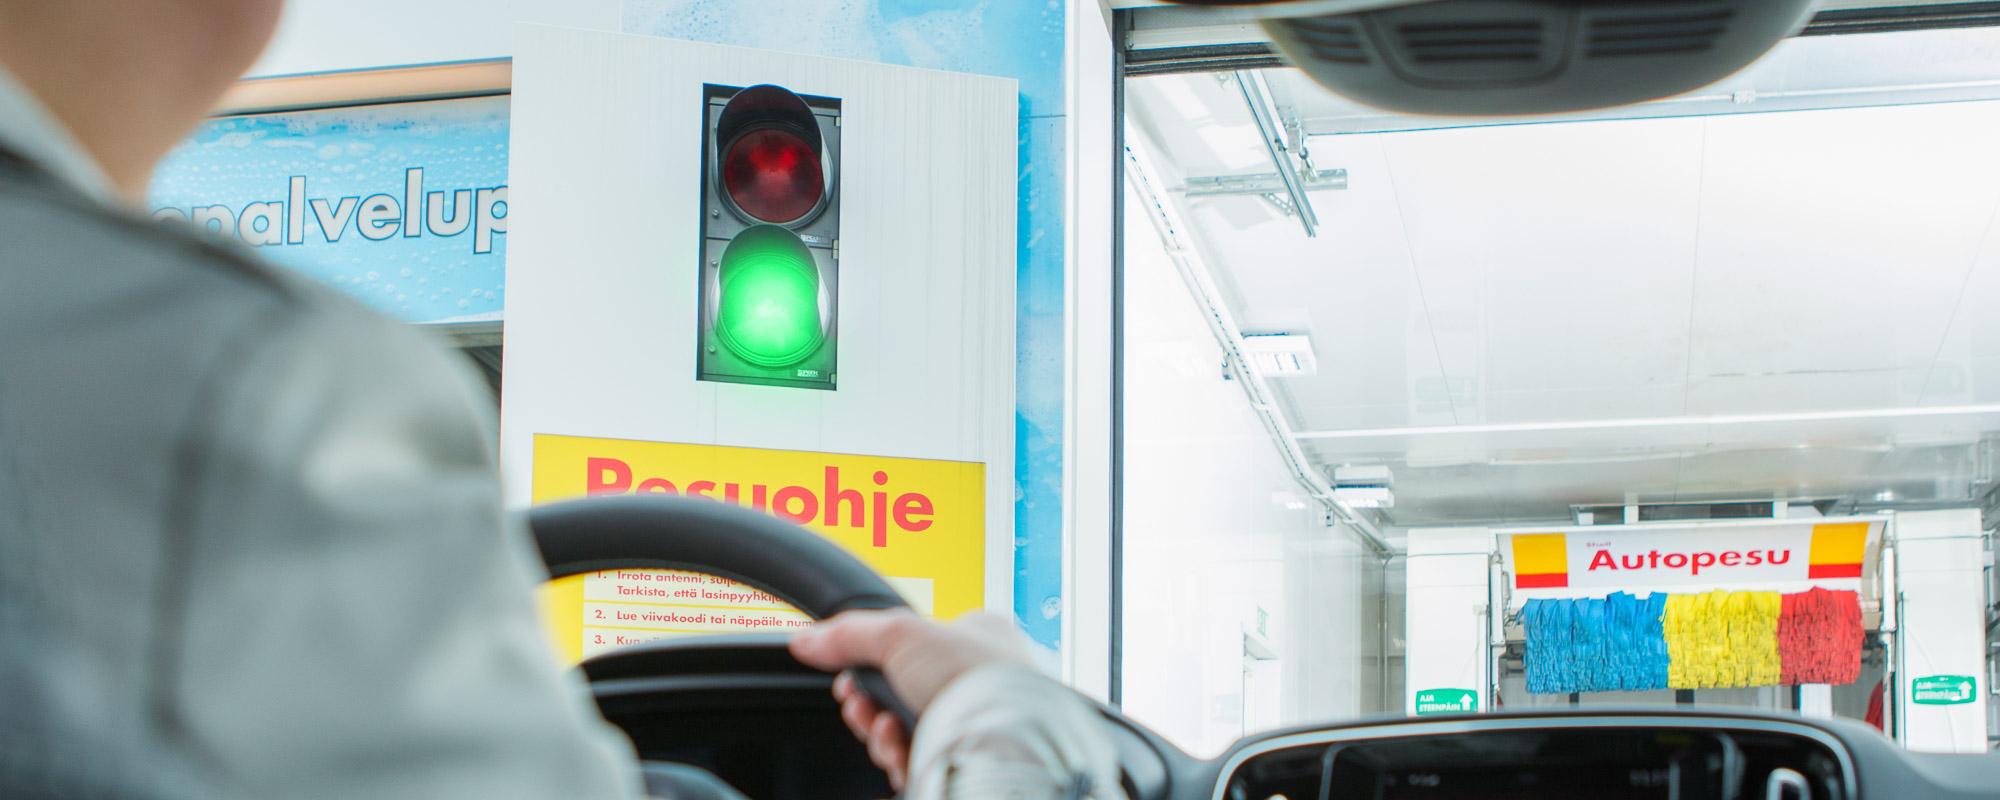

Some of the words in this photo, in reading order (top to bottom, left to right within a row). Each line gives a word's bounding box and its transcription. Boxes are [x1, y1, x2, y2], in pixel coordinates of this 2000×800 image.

[1588, 549, 1791, 575] Autopesu
[617, 570, 652, 581] Irrota
[656, 573, 706, 584] antenni,
[617, 585, 670, 597] Tarkista,
[674, 588, 697, 598] että
[595, 609, 606, 619] 2.
[617, 610, 638, 620] Lue
[641, 612, 706, 624] viivakoodi
[710, 614, 726, 624] tai
[730, 616, 783, 628] näppäile
[594, 635, 606, 645] 3.
[616, 636, 641, 646] Kun
